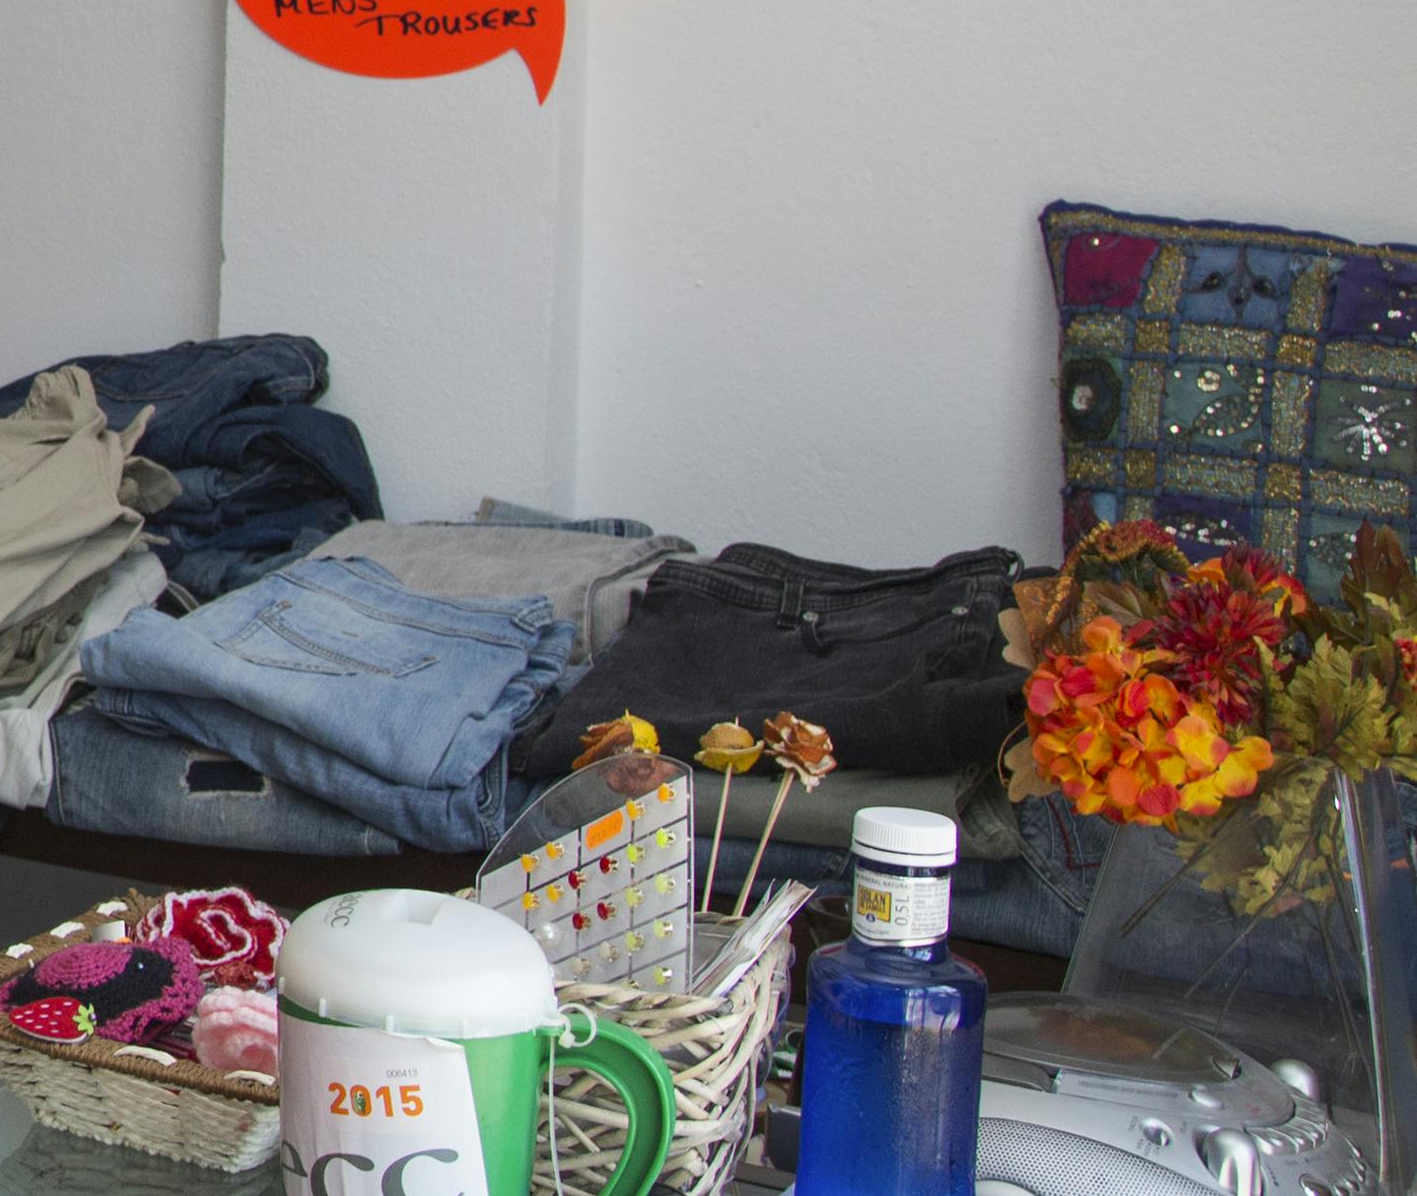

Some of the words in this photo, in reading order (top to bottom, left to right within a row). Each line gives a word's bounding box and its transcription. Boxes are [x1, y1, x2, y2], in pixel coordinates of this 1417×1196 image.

[355, 6, 537, 37] TROUSERS
[386, 1068, 418, 1078] 006413
[327, 1081, 425, 1118] 2015
